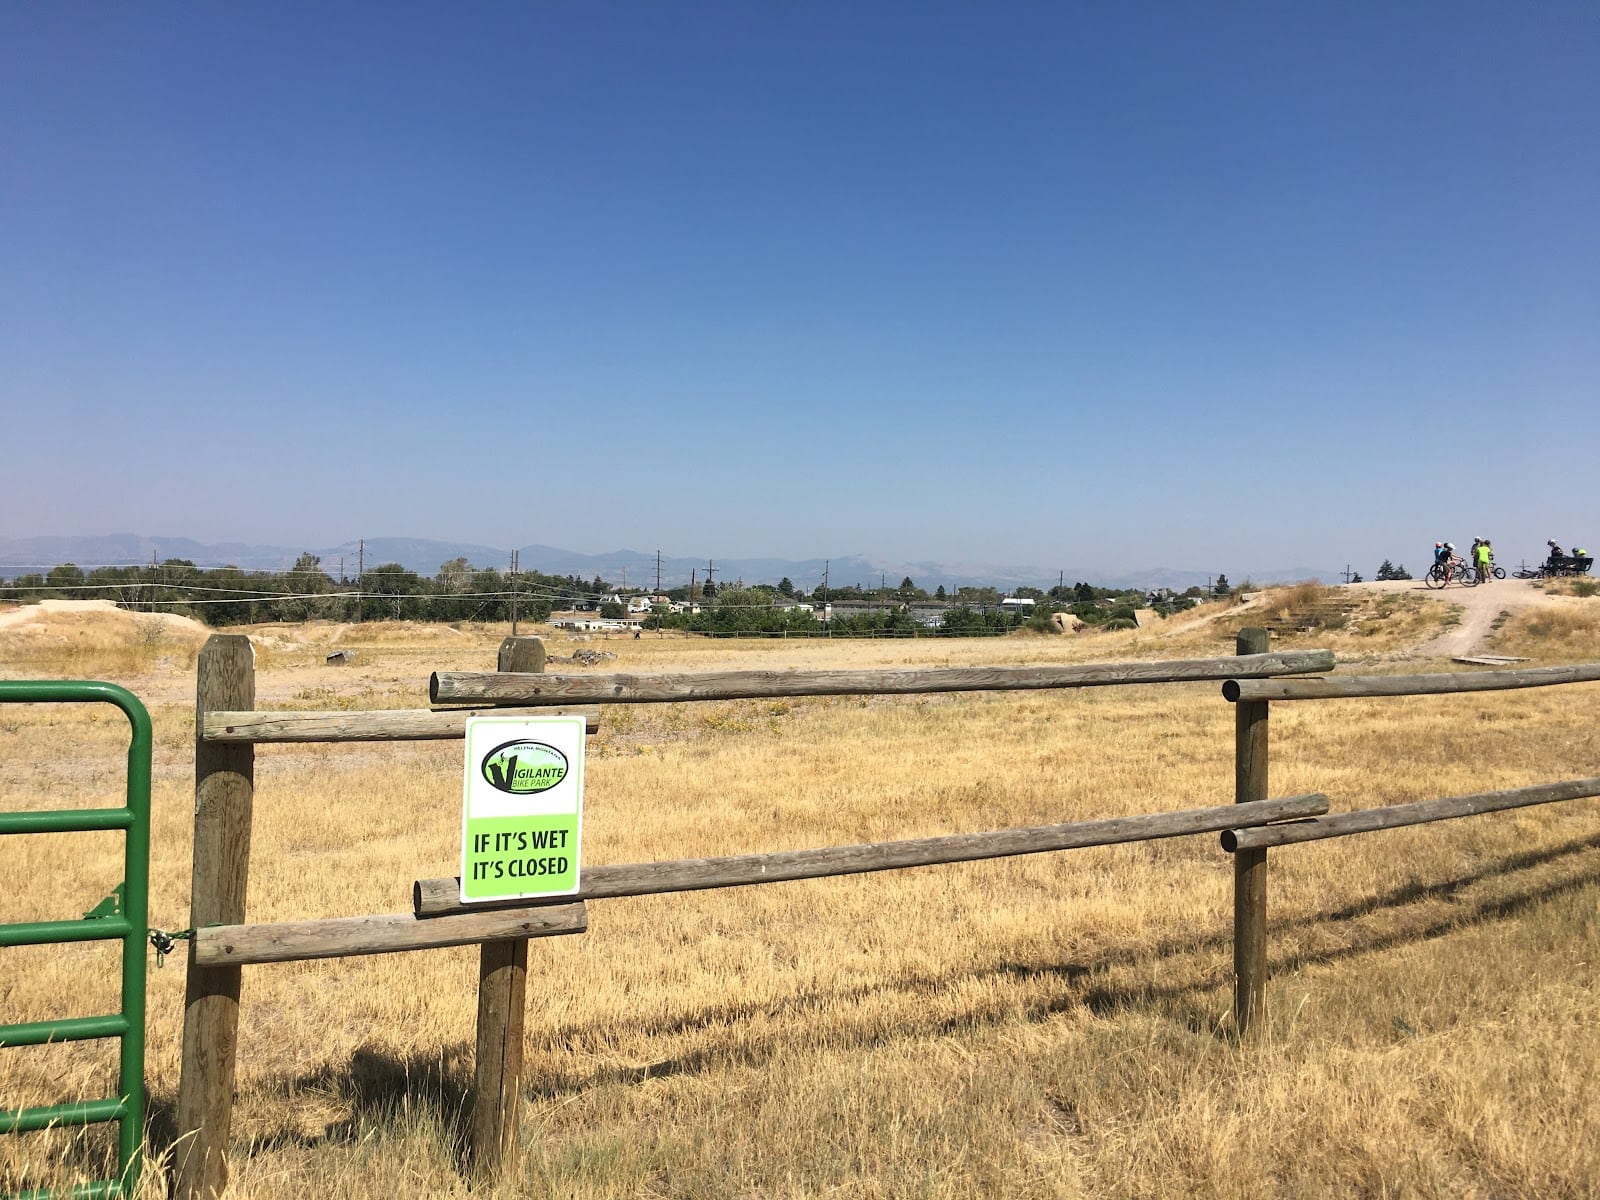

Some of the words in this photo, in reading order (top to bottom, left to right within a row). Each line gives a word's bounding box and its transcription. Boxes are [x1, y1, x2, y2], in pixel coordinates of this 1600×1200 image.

[488, 755, 564, 790] VIGILANTE
[512, 779, 529, 788] BIKE
[530, 779, 551, 787] PARK
[474, 833, 490, 853] IF
[532, 829, 569, 850] WET
[508, 857, 568, 877] CLOSED
